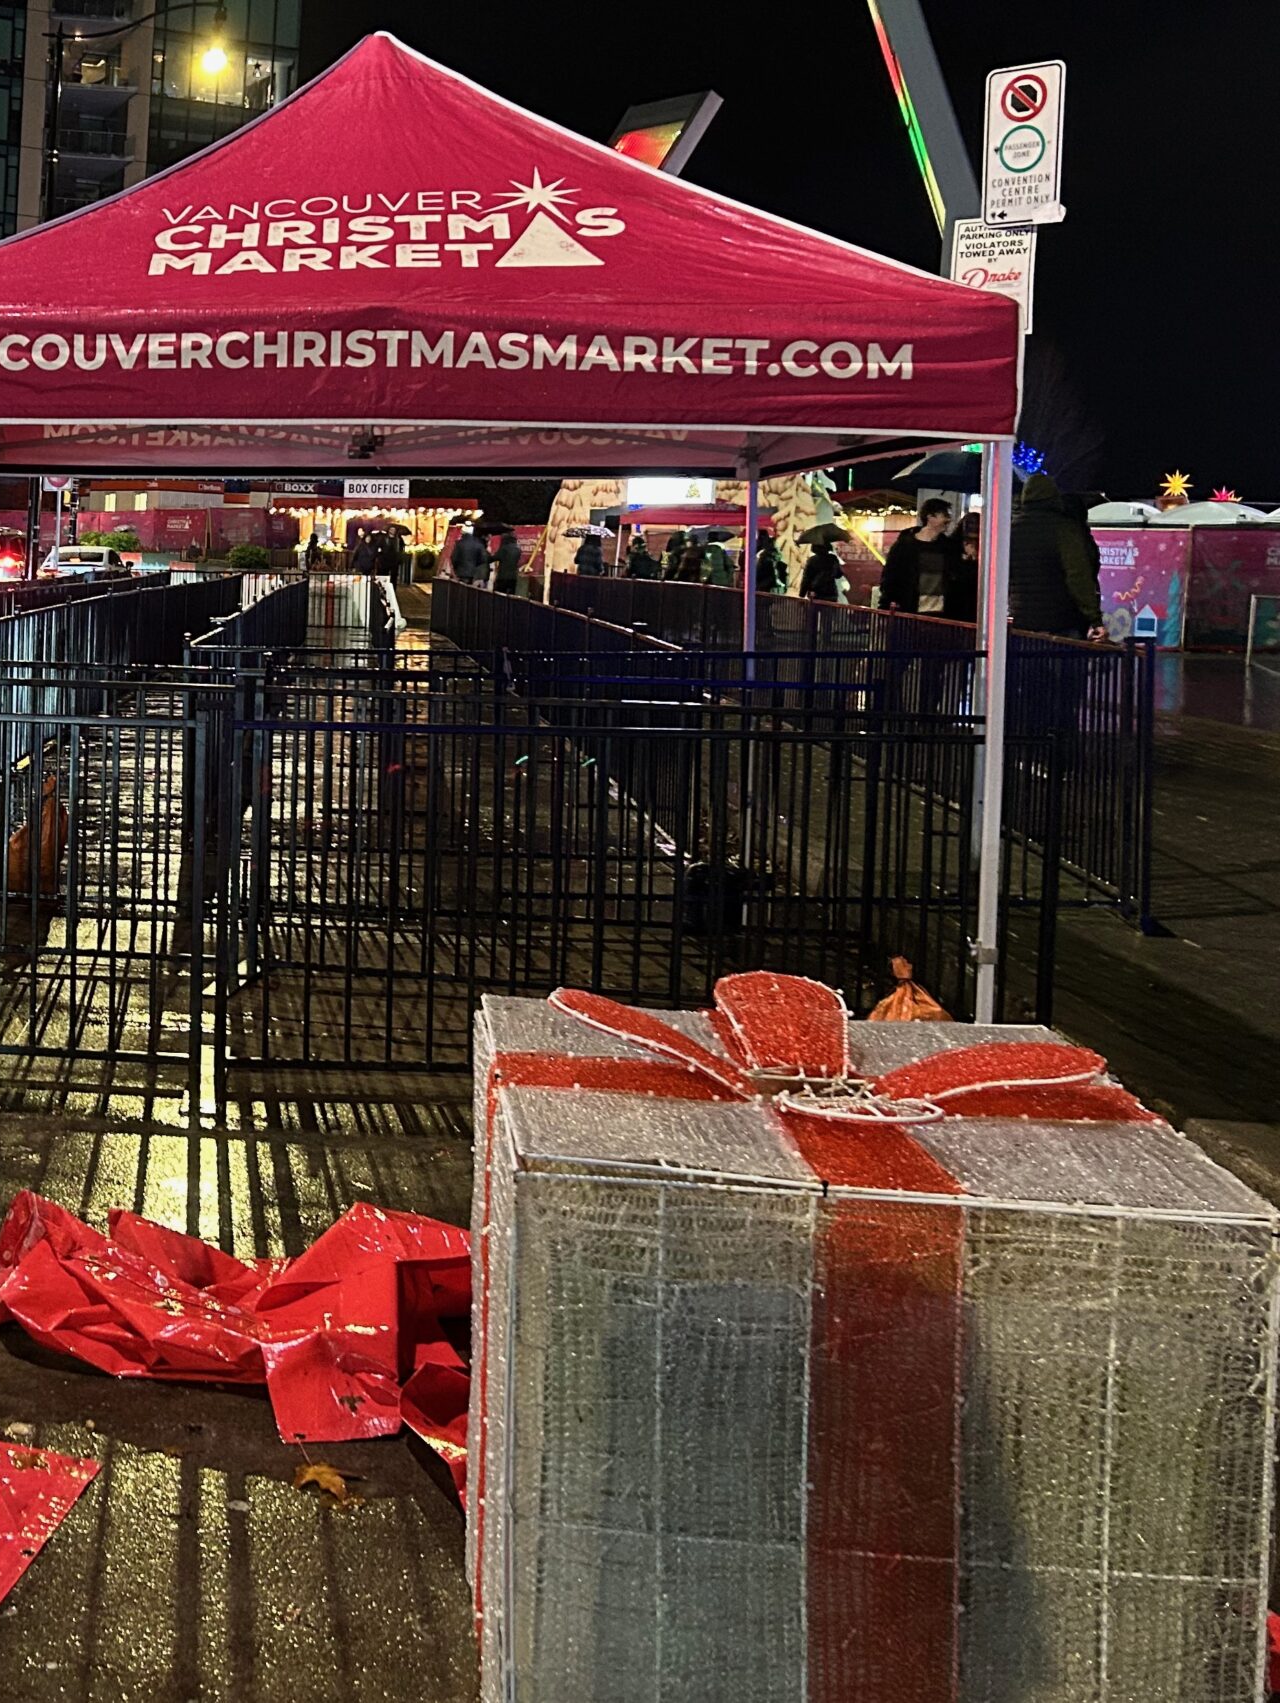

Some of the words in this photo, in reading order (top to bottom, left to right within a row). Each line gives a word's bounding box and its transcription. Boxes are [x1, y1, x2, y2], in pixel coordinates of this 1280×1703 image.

[1004, 140, 1040, 151] PASSENGER
[1011, 151, 1030, 160] ZONE
[991, 173, 1051, 188] CONVENTION
[1001, 184, 1039, 197] CENTRE
[161, 190, 482, 224] VANCOUVER
[990, 197, 1025, 208] PERMIT
[1027, 195, 1050, 204] ONLY
[960, 231, 1002, 241] PARKING
[1005, 228, 1030, 238] ONLY
[965, 240, 1023, 250] VIOLATORS
[147, 243, 493, 276] MARKET
[959, 250, 995, 259] TOWED
[998, 247, 1029, 256] AWAY
[961, 267, 1022, 289] Drake
[284, 483, 315, 492] BOXX
[348, 483, 368, 494] BOX
[370, 483, 405, 494] OFFICE
